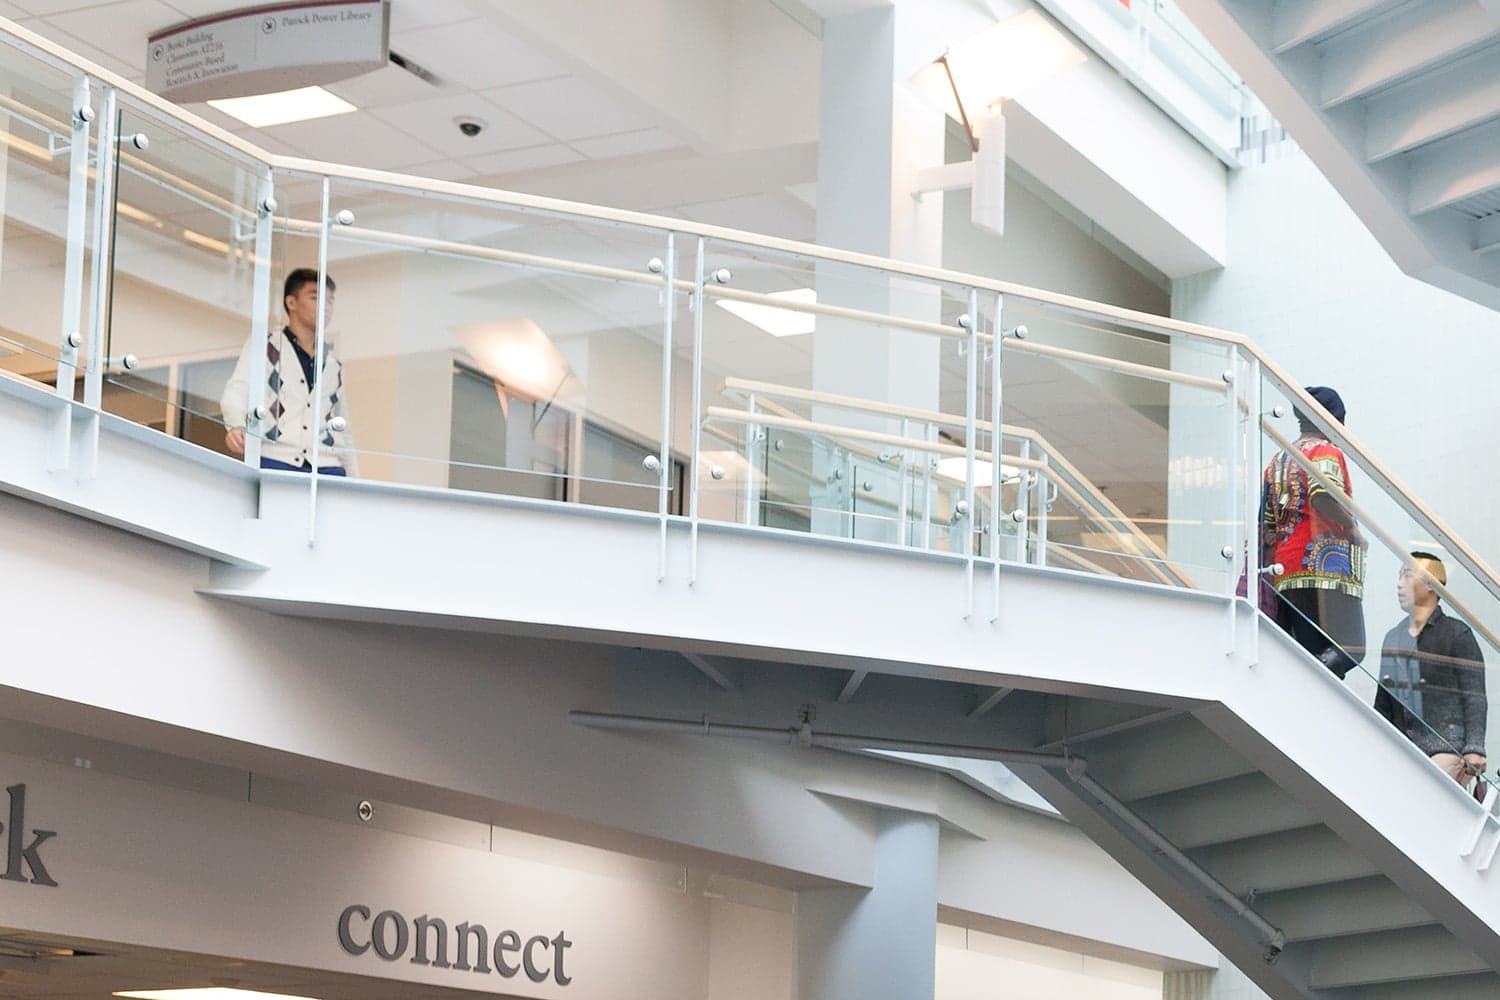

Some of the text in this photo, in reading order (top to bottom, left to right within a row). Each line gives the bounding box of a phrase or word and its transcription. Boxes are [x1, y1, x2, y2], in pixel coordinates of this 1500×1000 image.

[312, 13, 338, 24] Power
[340, 9, 373, 23] Library
[0, 783, 58, 887] k
[337, 904, 573, 986] connect
